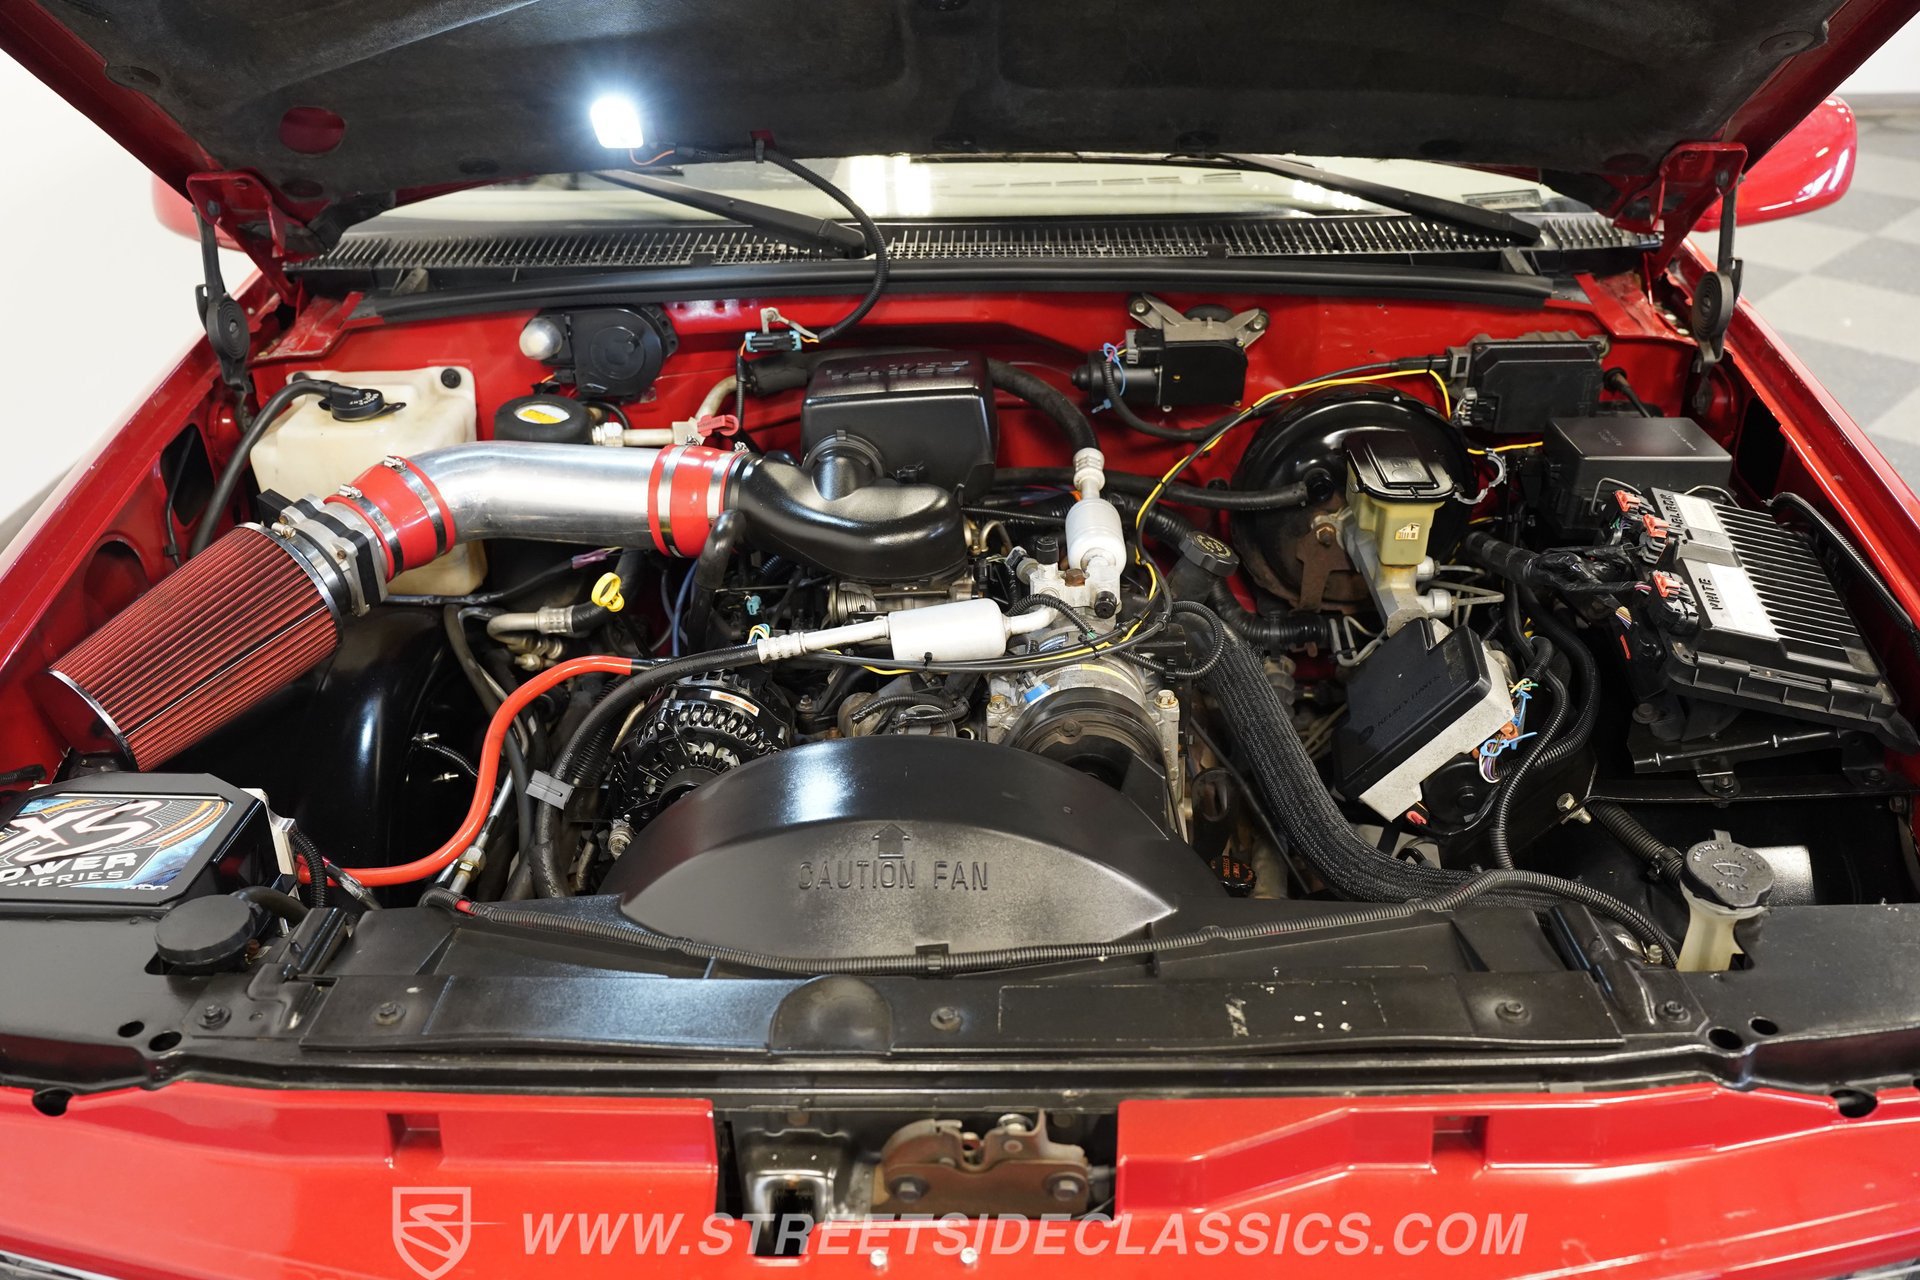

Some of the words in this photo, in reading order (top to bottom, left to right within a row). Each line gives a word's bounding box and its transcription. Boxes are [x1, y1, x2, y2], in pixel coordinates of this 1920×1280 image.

[1698, 578, 1723, 610] WHITE
[0, 852, 137, 883] OWER
[6, 871, 124, 887] TERIES
[798, 860, 916, 890] CAUTION
[934, 860, 988, 890] FAN
[1716, 880, 1749, 890] ONLY
